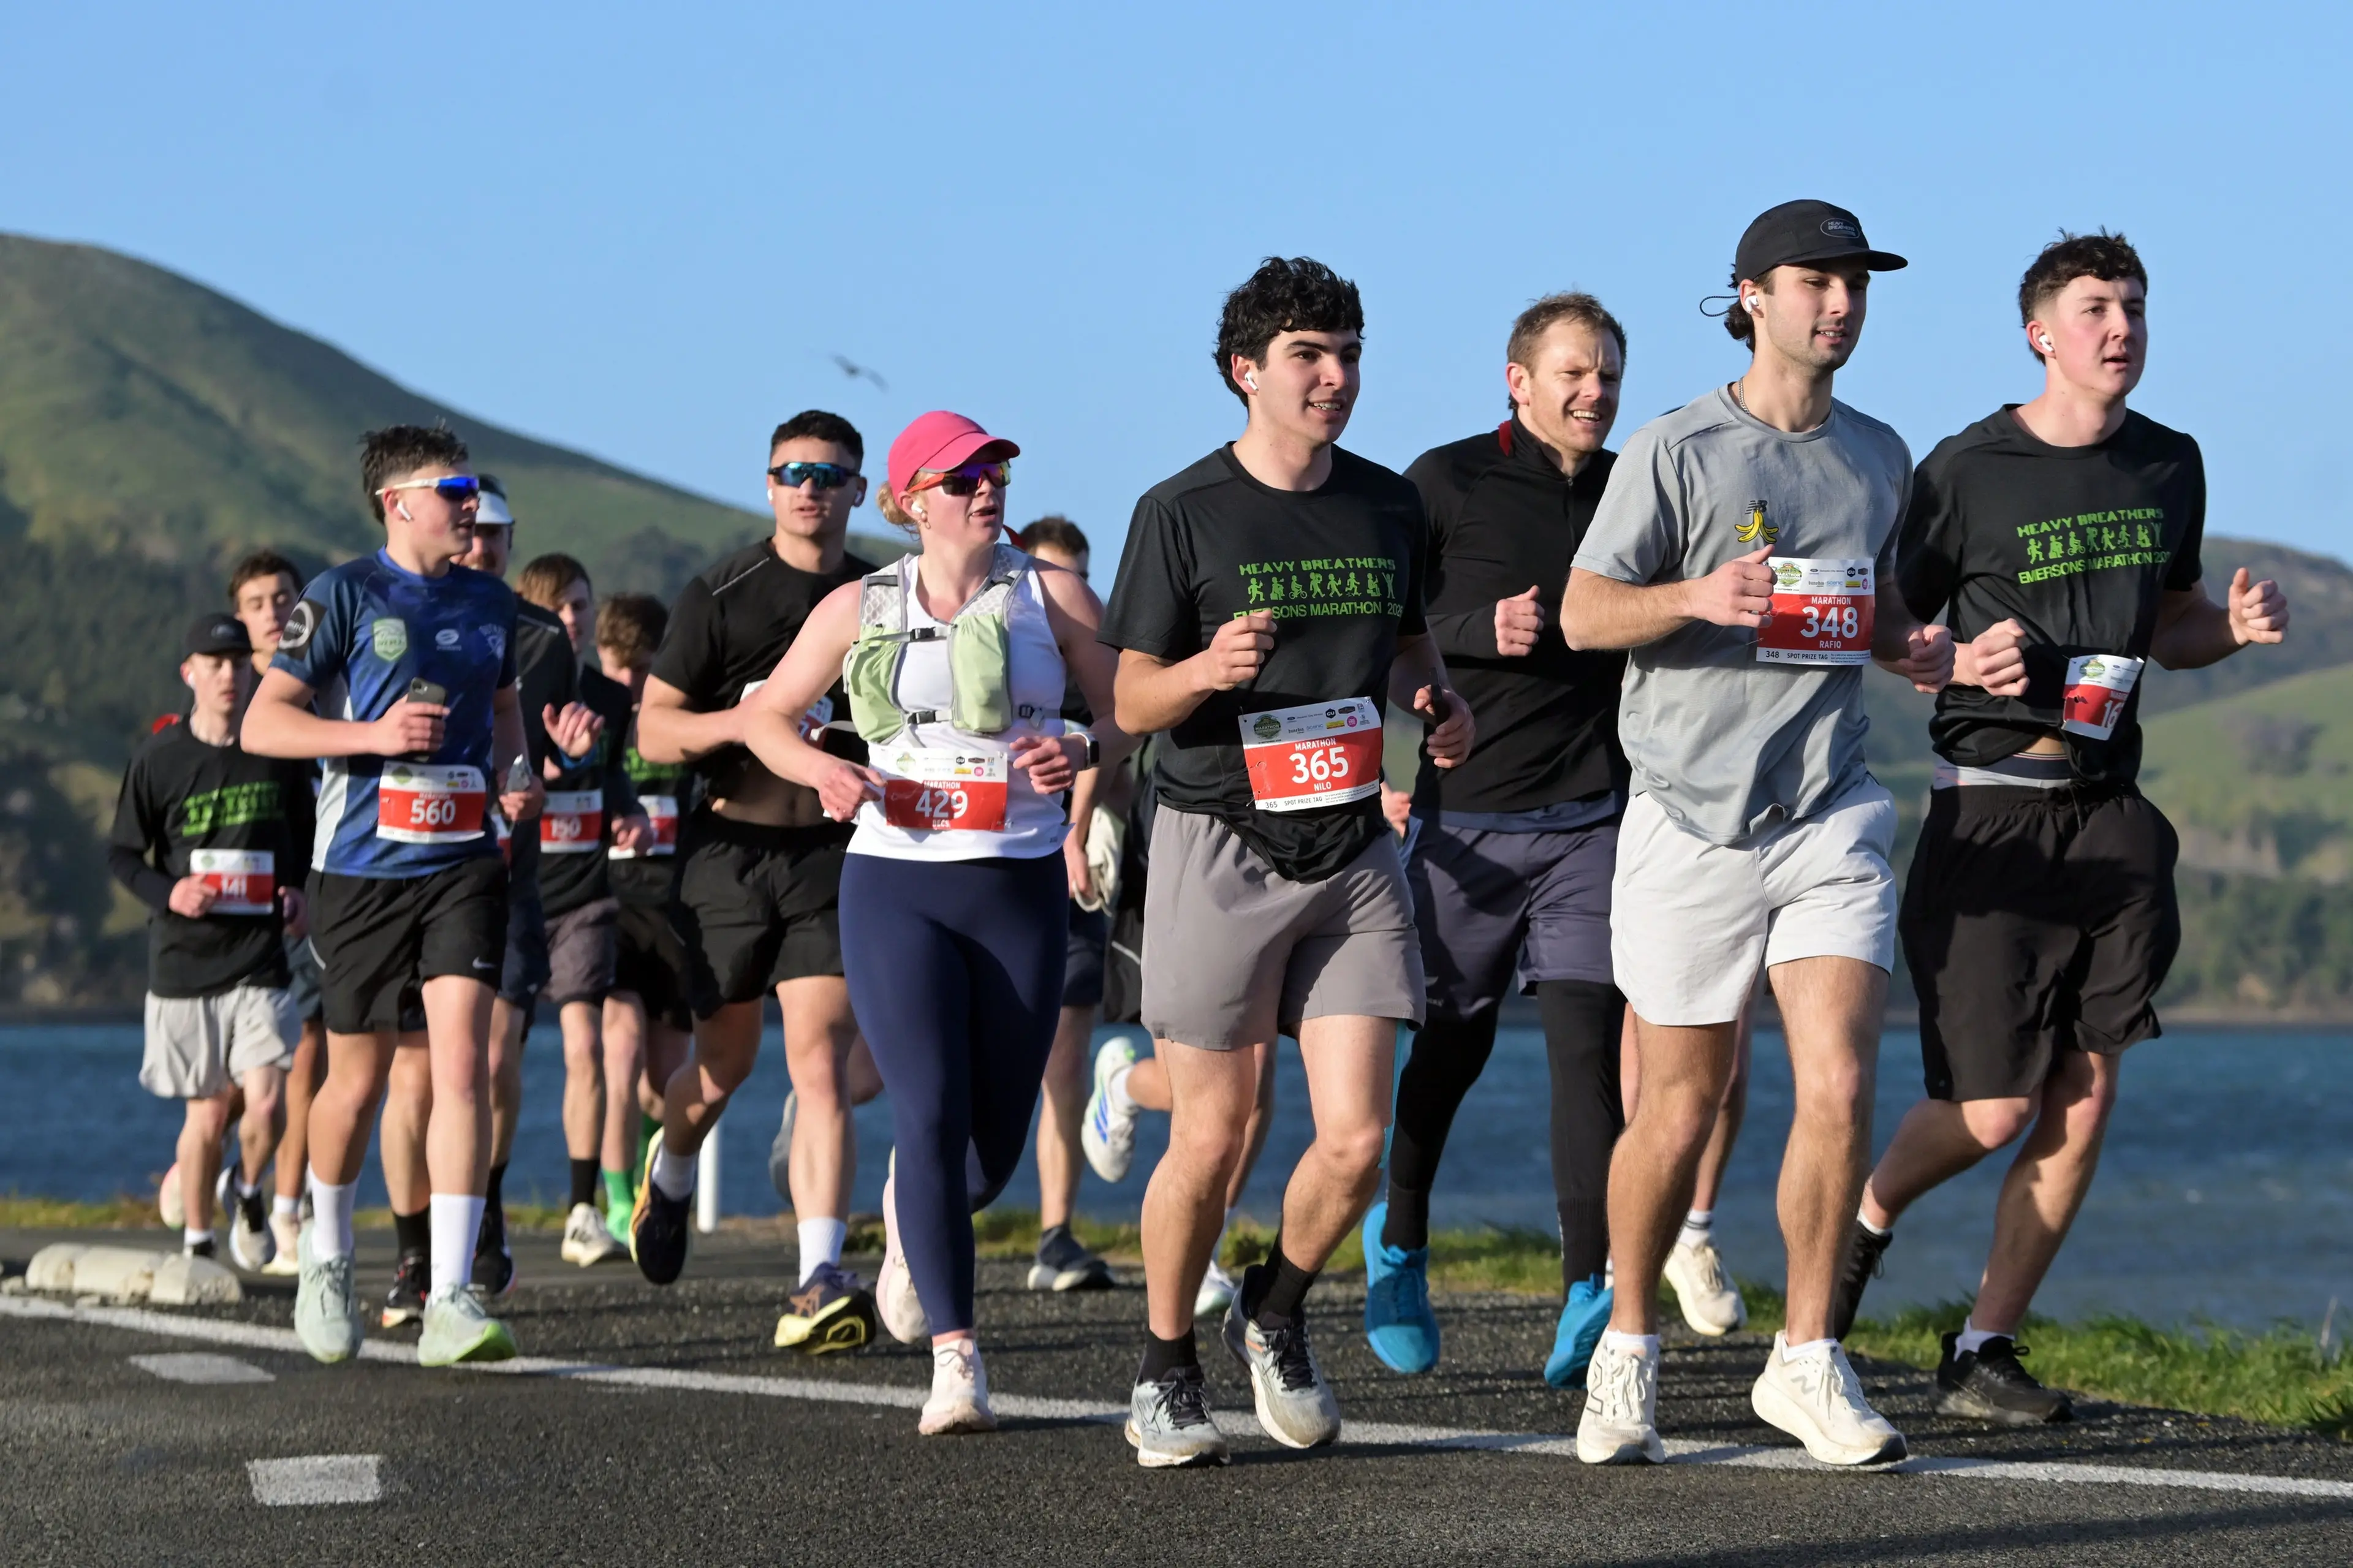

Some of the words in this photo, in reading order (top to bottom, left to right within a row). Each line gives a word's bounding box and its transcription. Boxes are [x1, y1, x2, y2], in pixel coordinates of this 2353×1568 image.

[2017, 517, 2072, 537] HEAVY
[2077, 508, 2164, 526] BREATHERS
[1239, 561, 1295, 576] HEAVY
[1300, 557, 1396, 571] BREATHERS
[2018, 559, 2086, 584] EMERSONS
[2088, 552, 2152, 570] MARATHON
[1309, 601, 1382, 616] MARATHON
[1811, 596, 1851, 605] MARATHON
[1800, 606, 1858, 638] 348
[1819, 640, 1841, 649] RAFIQ
[1295, 737, 1336, 751] MARATHON
[1289, 746, 1348, 784] 365
[923, 781, 961, 789] MARATHON
[1314, 781, 1332, 792] NILO
[410, 798, 456, 825] 560
[915, 790, 968, 819] 429
